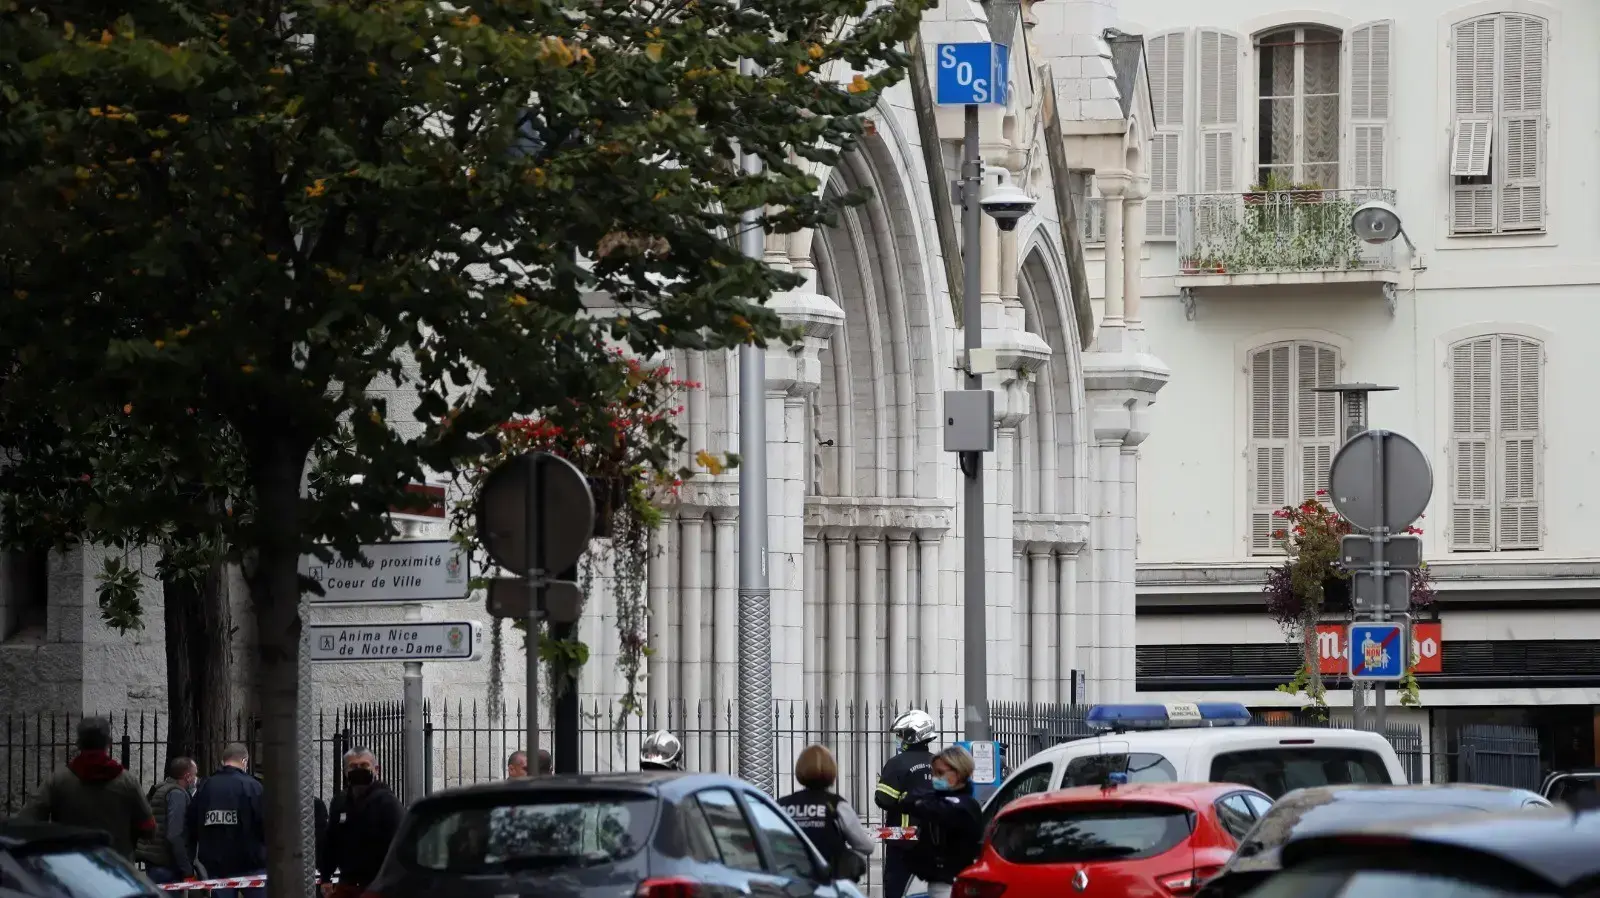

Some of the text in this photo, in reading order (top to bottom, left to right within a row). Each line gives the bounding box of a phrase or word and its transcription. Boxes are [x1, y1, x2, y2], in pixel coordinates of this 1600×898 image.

[941, 45, 988, 103] SOS
[381, 555, 441, 570] proximité
[327, 575, 421, 589] Coeur de Ville
[339, 629, 418, 641] Anima Nice
[339, 644, 354, 655] de
[361, 643, 442, 655] Notre-Dame
[205, 811, 237, 823] POLICE
